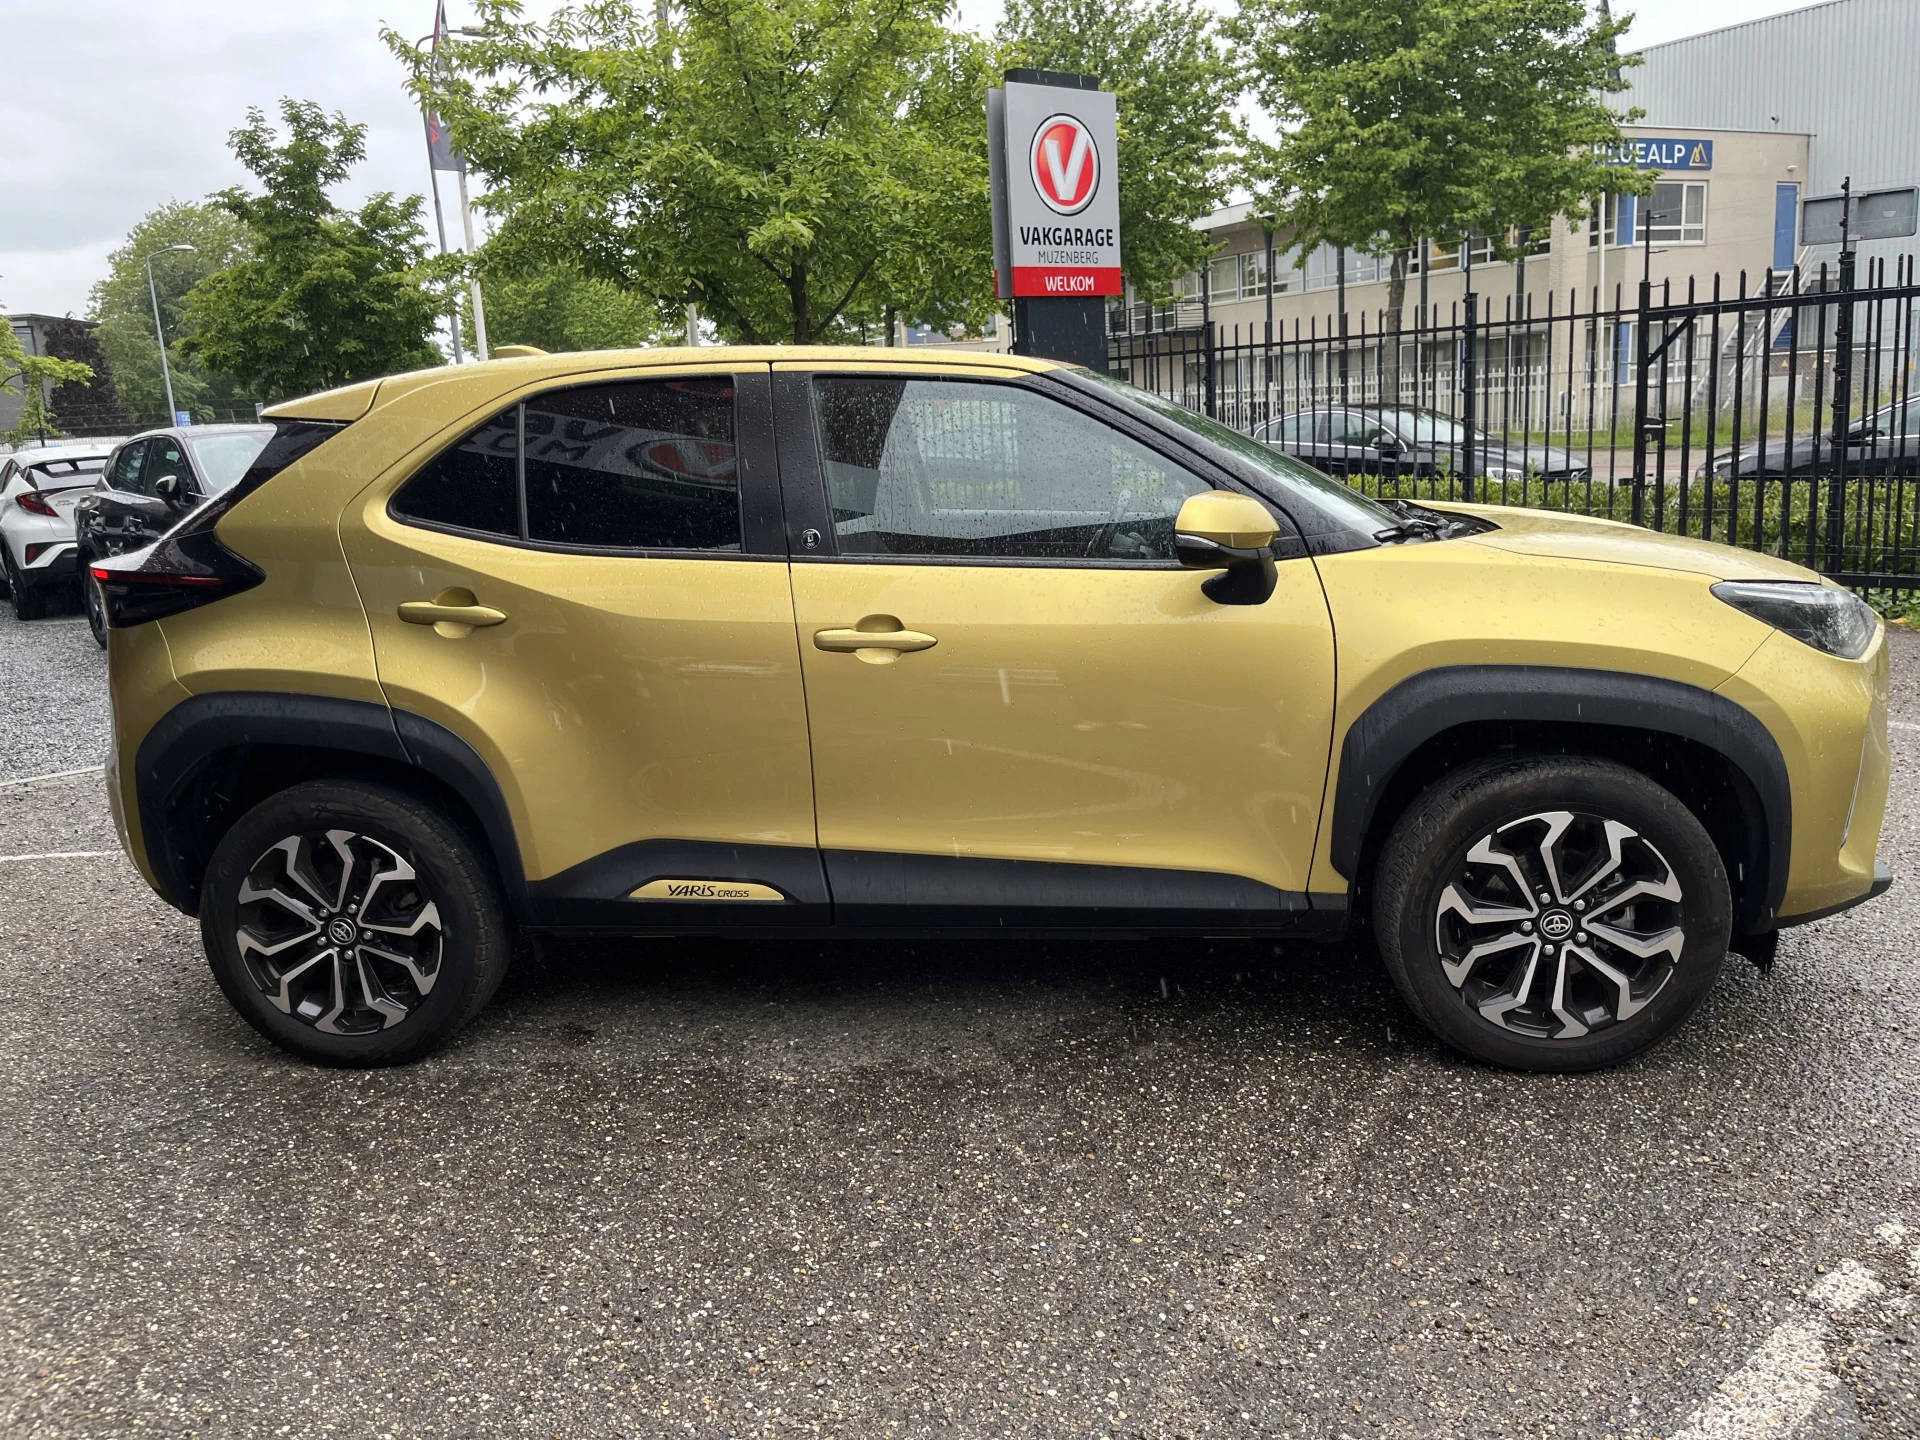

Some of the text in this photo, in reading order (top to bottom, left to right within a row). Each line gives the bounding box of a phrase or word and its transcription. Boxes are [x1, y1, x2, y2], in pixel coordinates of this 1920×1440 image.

[1020, 226, 1114, 247] VAKGARAGE
[1038, 250, 1099, 264] MUZENBERG
[1045, 275, 1095, 291] WELKOM
[717, 889, 750, 898] CROSS
